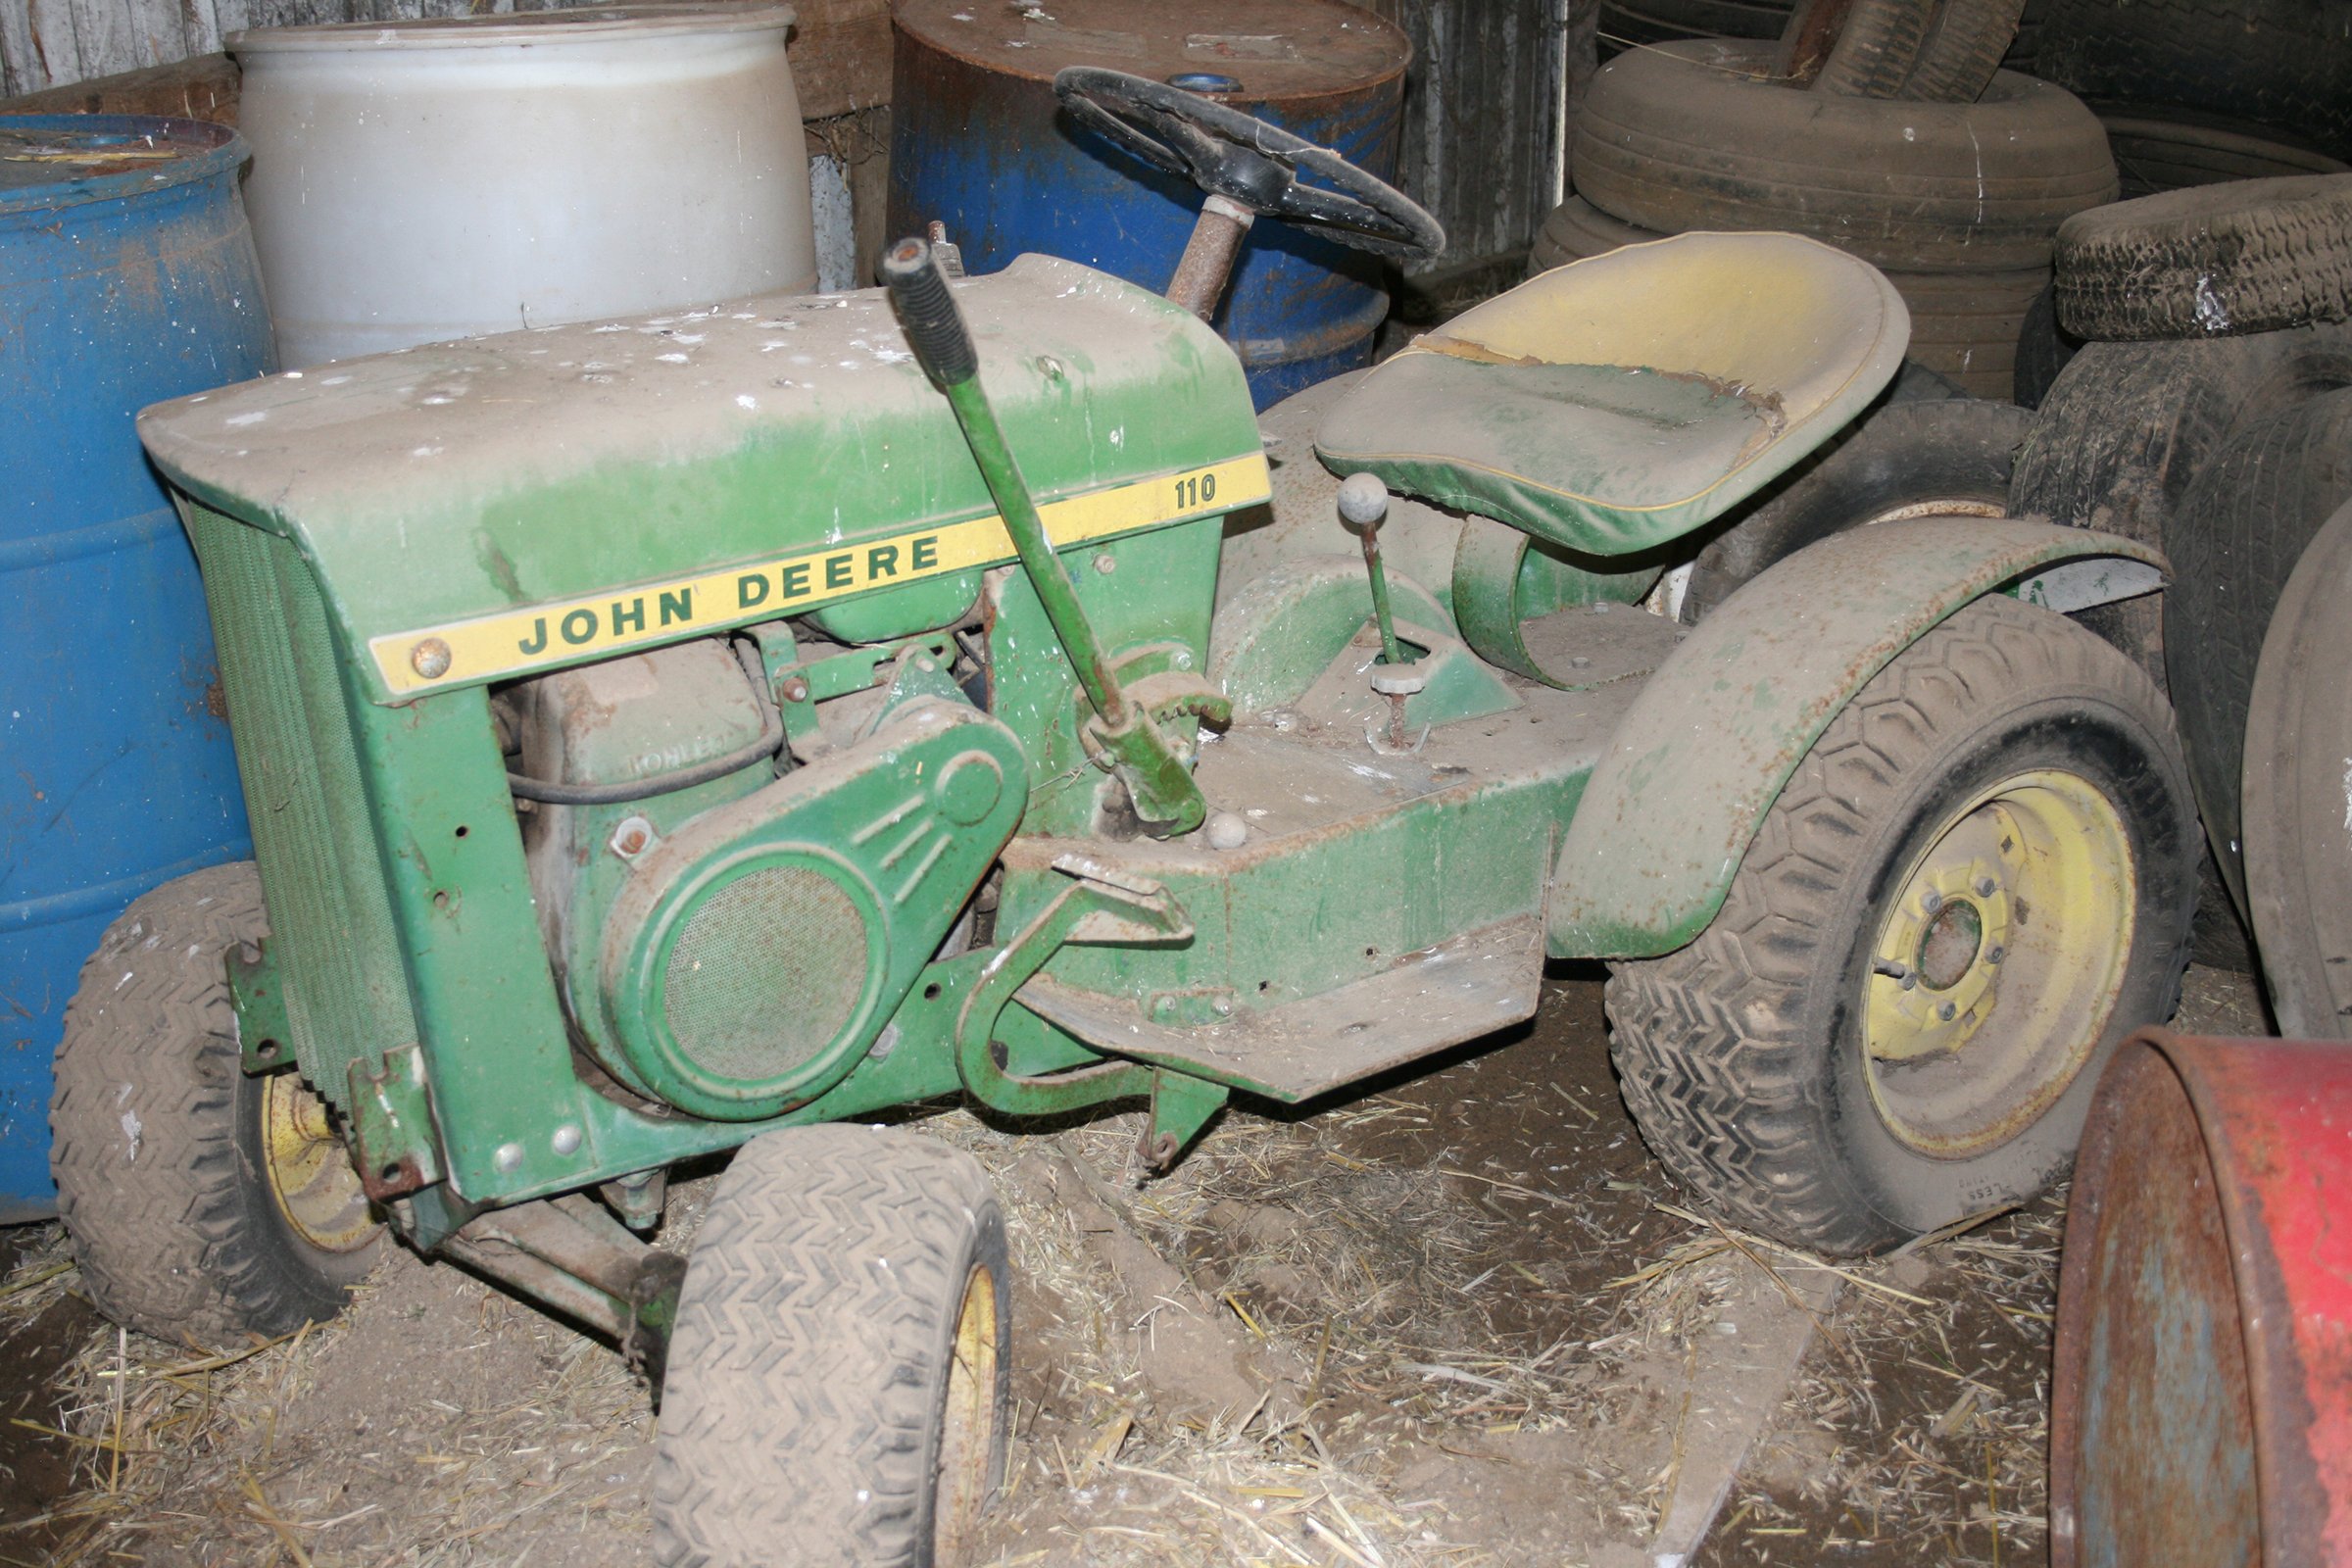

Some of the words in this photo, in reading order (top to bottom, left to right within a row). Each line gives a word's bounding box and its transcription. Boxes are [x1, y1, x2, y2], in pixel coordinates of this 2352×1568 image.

[1175, 473, 1215, 509] 110
[518, 588, 693, 656] JOHN
[738, 535, 938, 610] DEERE
